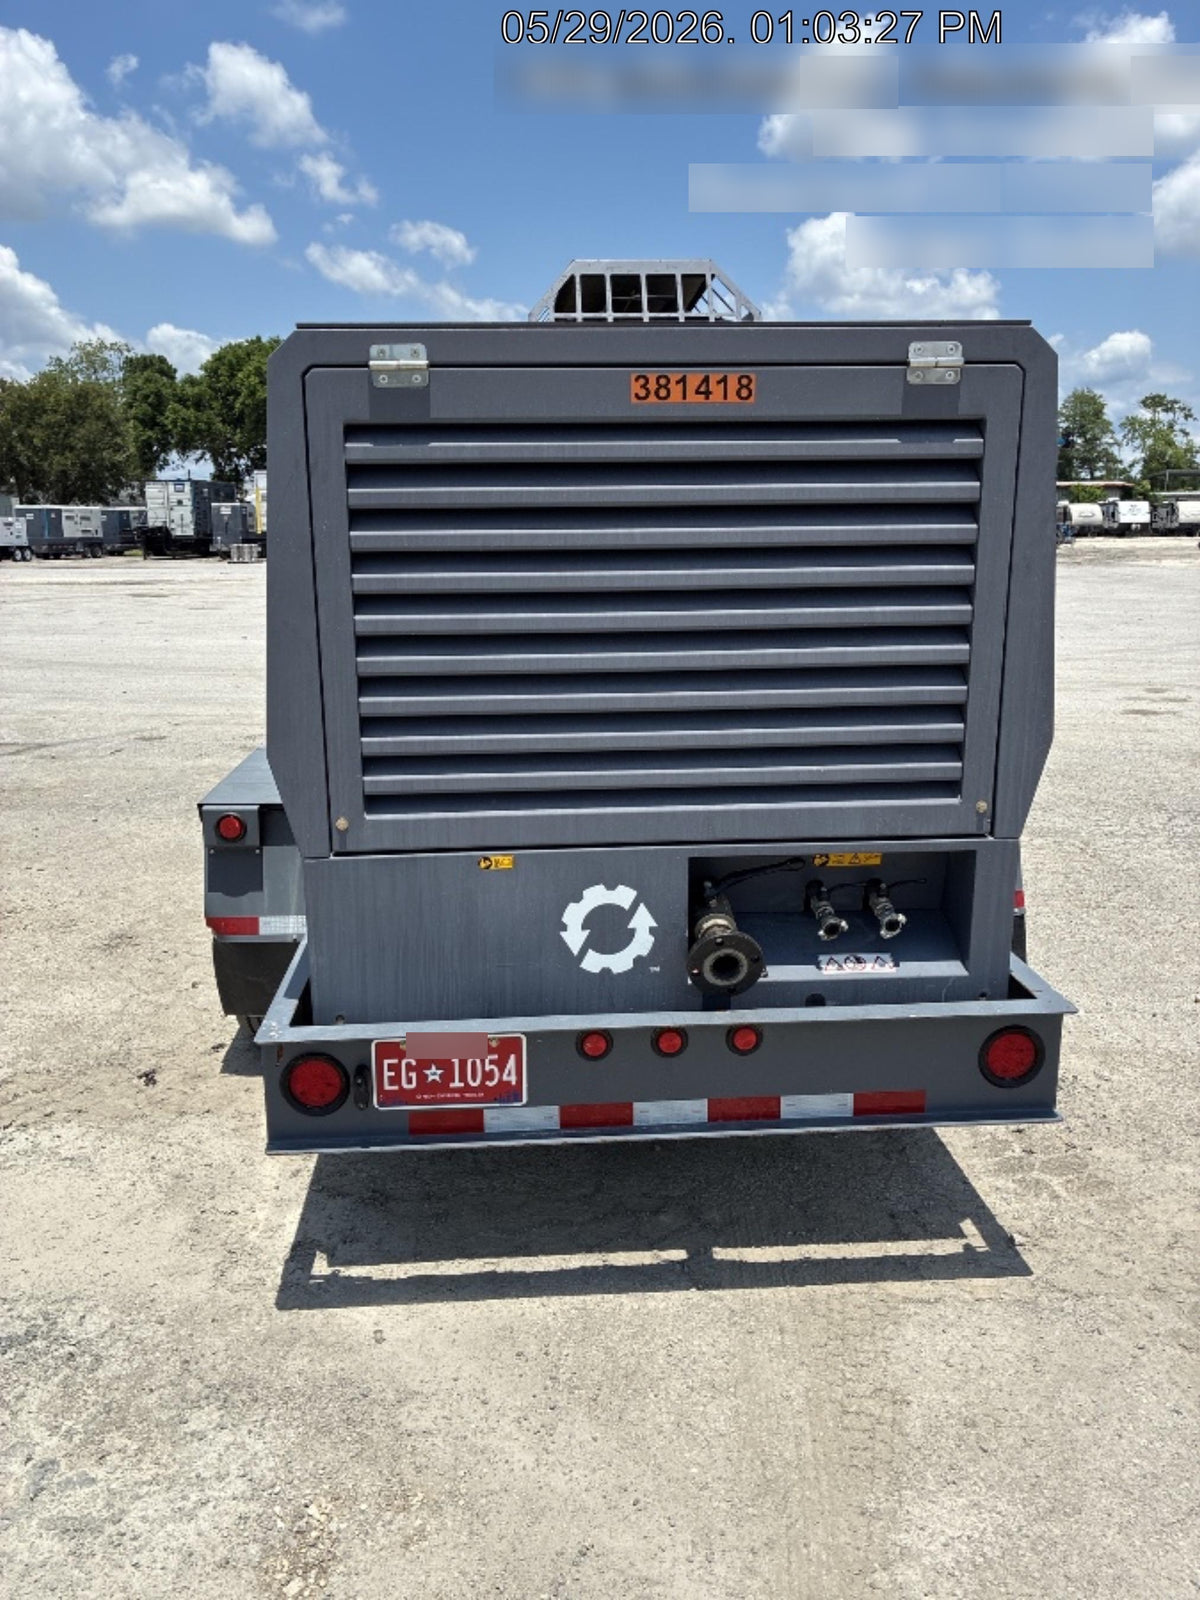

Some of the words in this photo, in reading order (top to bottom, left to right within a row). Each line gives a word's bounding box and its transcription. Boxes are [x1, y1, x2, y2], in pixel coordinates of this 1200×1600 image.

[634, 374, 753, 401] 381418
[383, 1058, 417, 1091] EG
[449, 1053, 517, 1088] 1054
